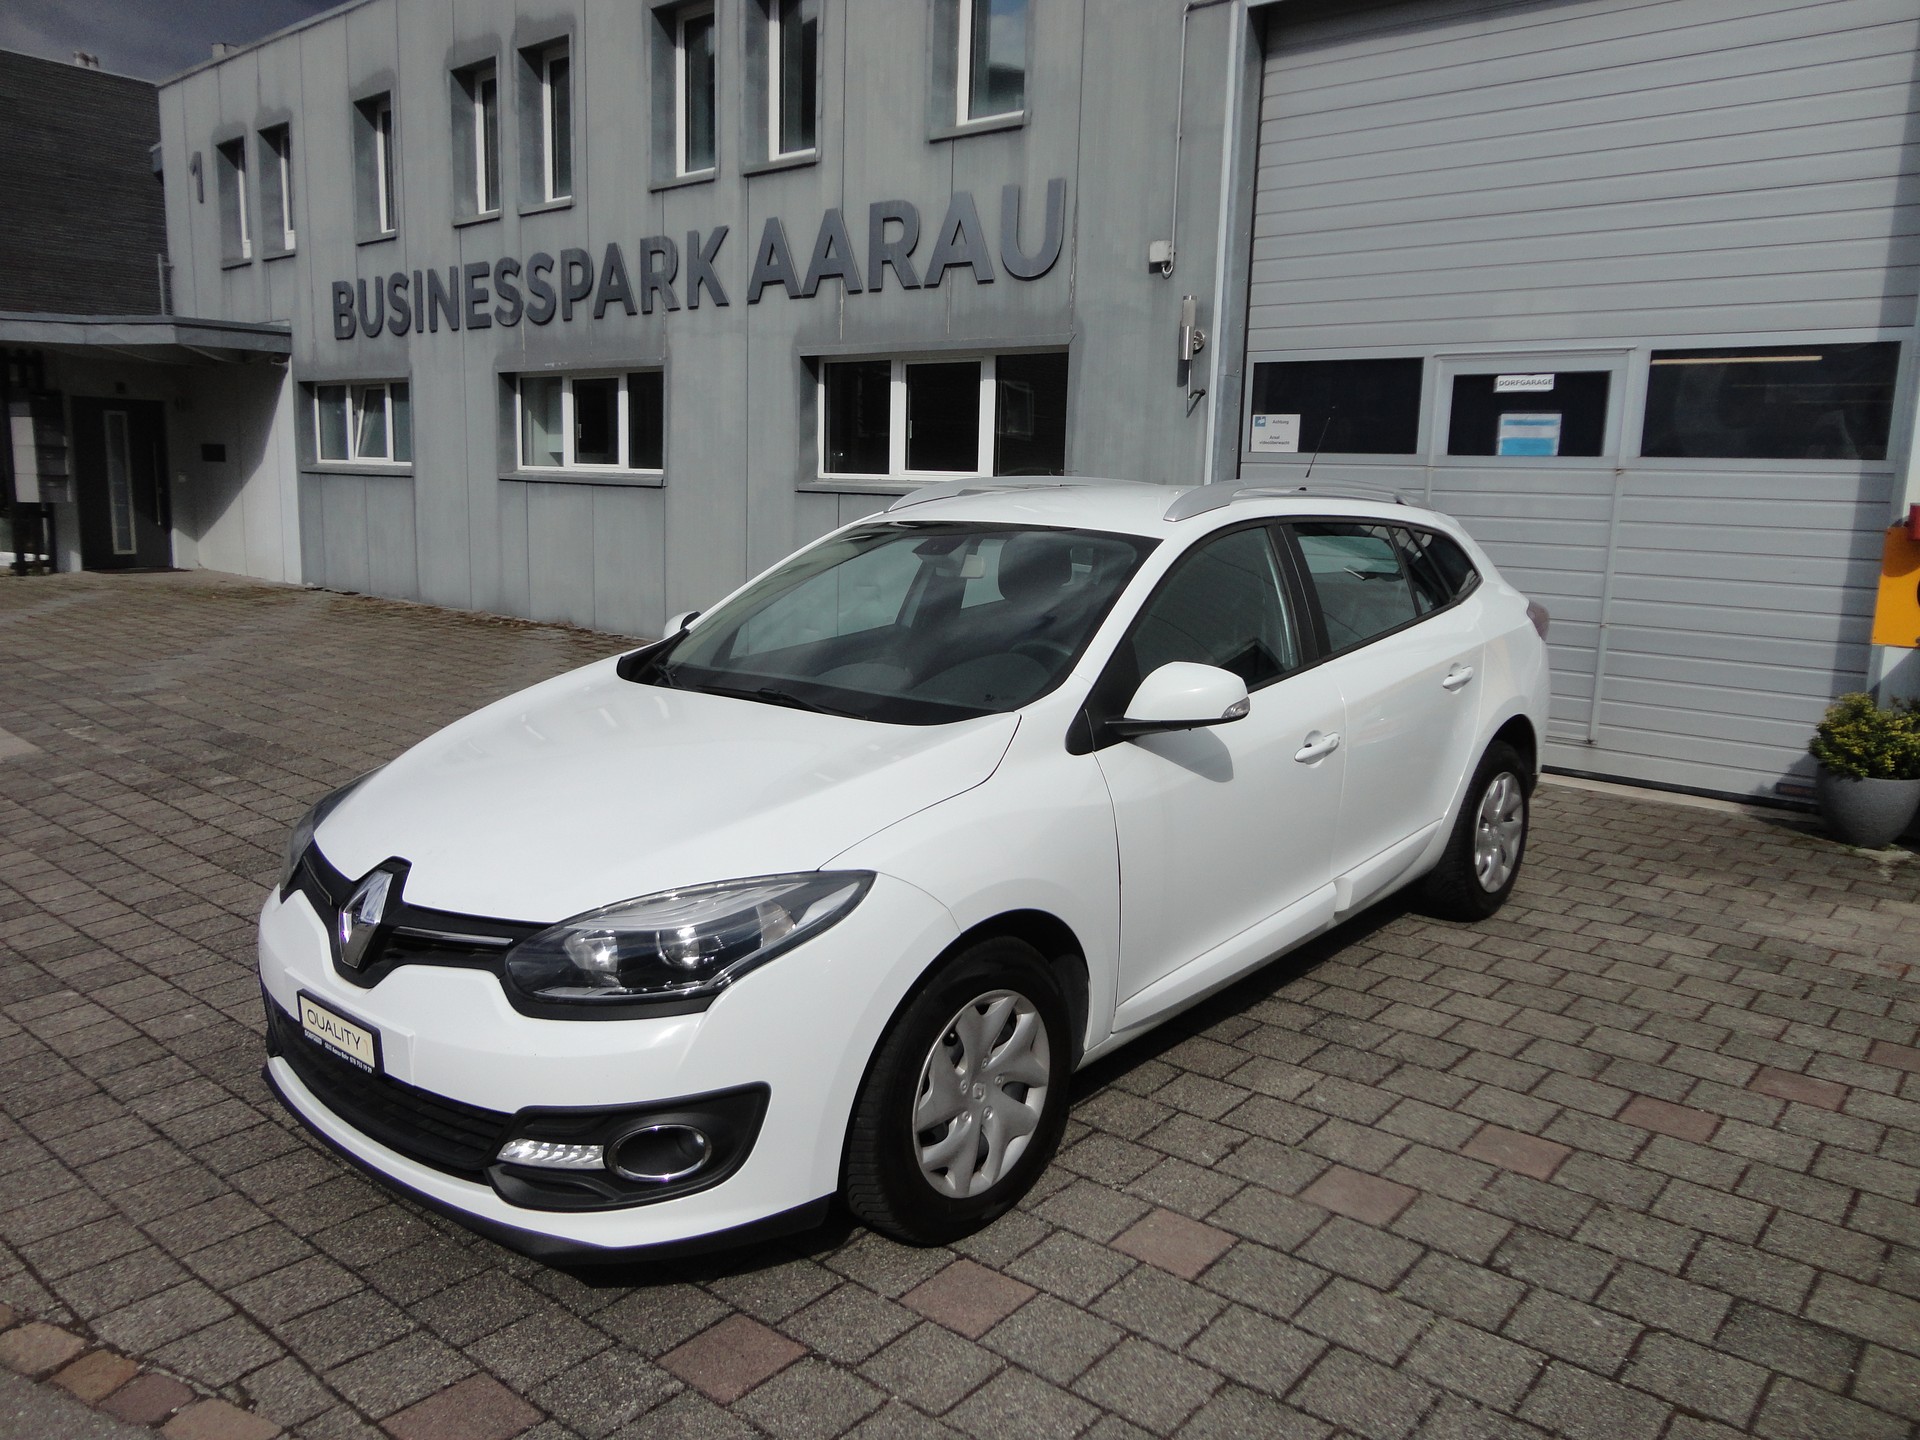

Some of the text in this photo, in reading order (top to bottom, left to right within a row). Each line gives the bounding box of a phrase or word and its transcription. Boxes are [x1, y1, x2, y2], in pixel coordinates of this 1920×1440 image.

[331, 178, 1066, 341] BUSINESSPARK AARAU
[1498, 378, 1553, 387] DORFGARAGE
[307, 1008, 361, 1051] QUALITY
